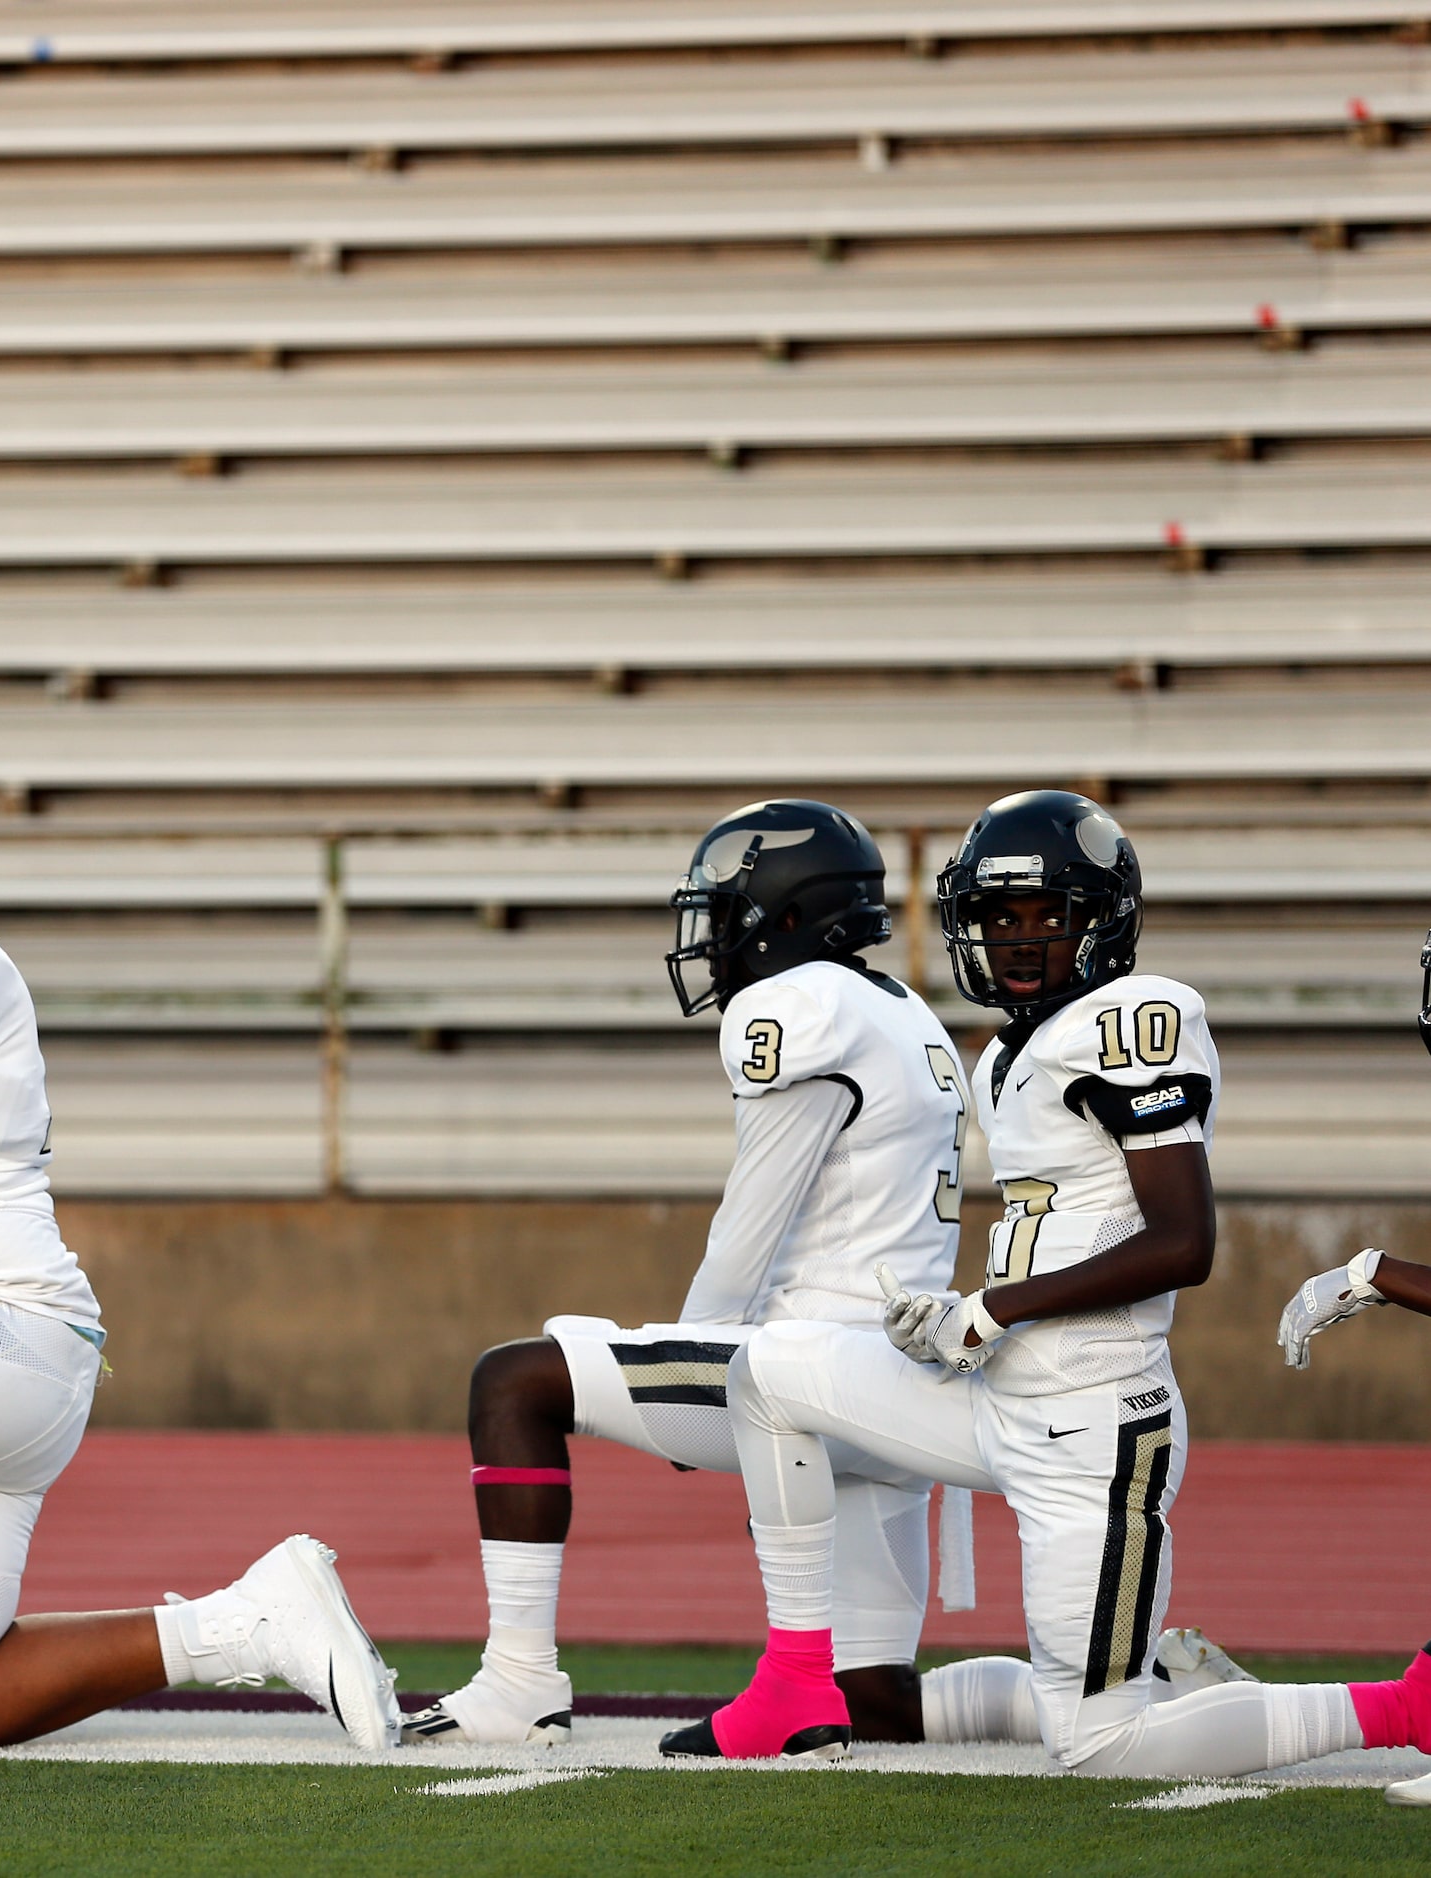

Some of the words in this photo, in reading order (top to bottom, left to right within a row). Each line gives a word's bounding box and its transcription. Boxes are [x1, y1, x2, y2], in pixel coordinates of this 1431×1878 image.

[742, 1018, 784, 1084] 3
[1095, 1000, 1182, 1071] 10
[1130, 1086, 1185, 1111] GEAR
[1122, 1385, 1170, 1411] VIKINGS
